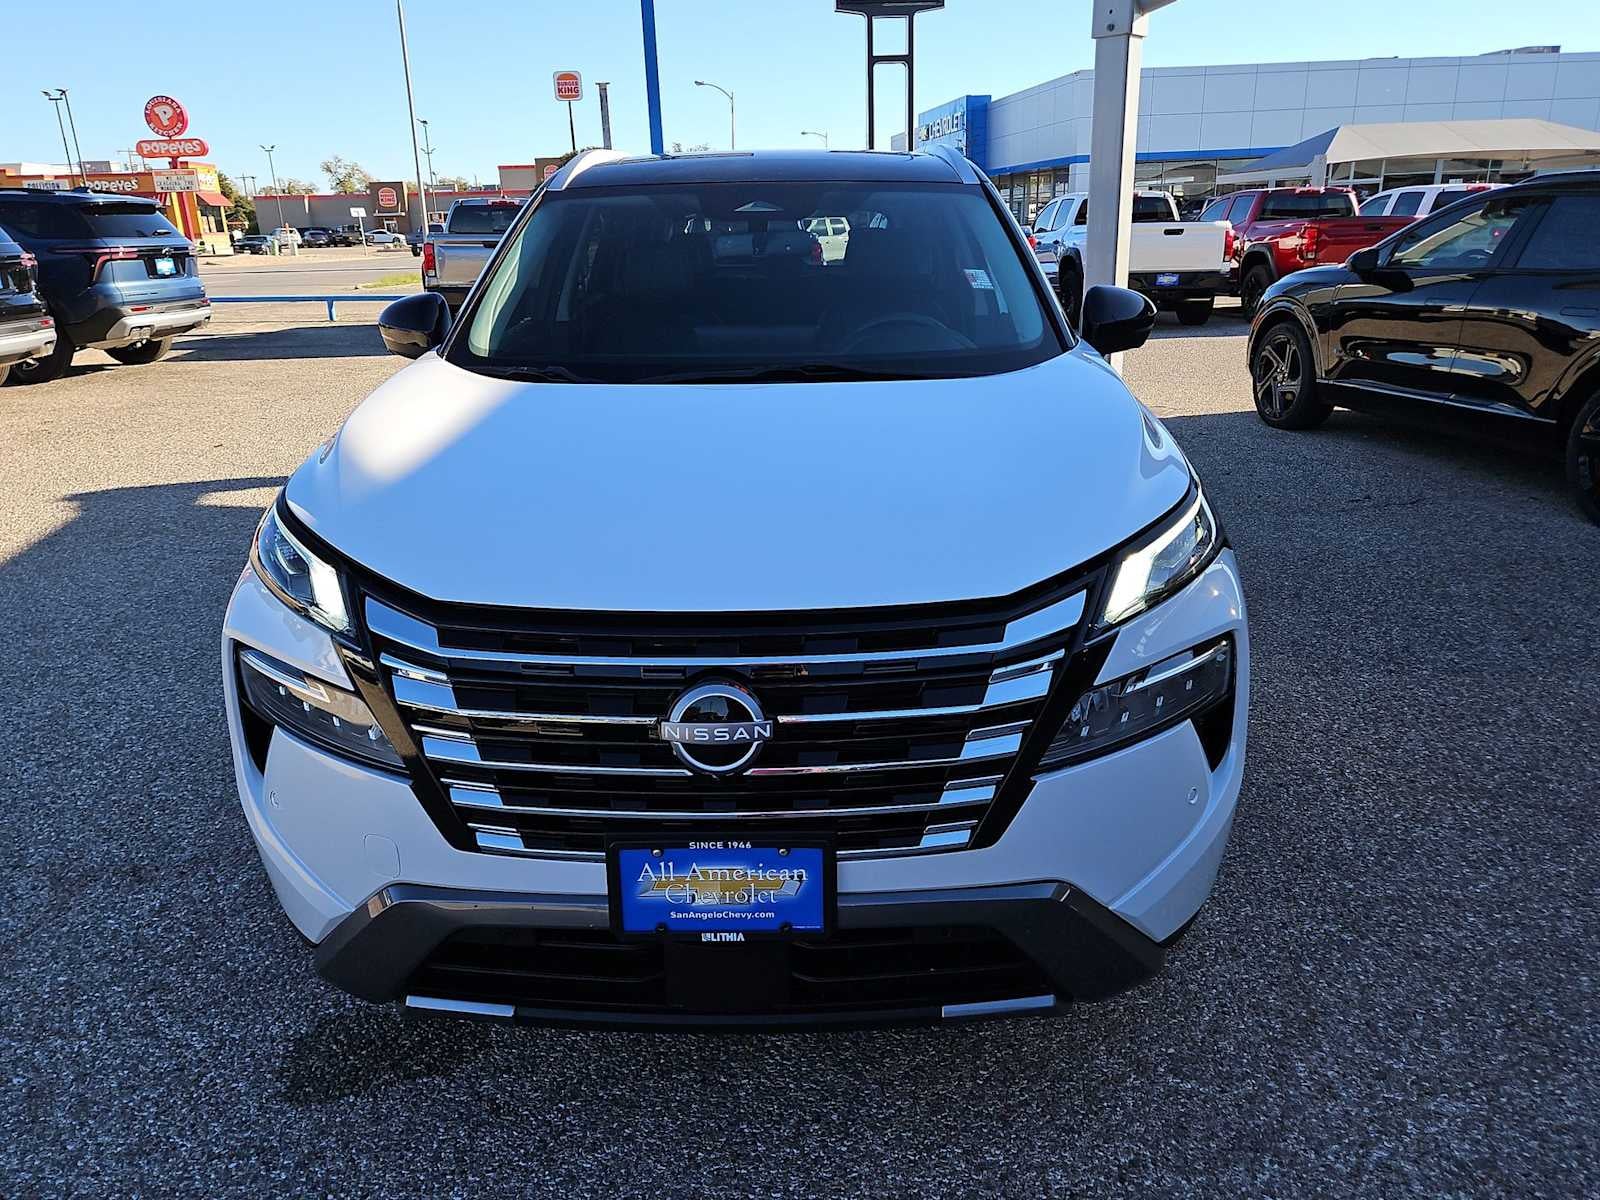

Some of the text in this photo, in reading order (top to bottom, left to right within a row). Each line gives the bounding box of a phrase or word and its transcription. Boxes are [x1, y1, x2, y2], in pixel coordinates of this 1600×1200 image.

[145, 97, 181, 114] LOUISIANA
[153, 104, 174, 127] P
[149, 121, 183, 136] KITCHEN
[929, 111, 964, 138] CHEVROLET
[664, 724, 771, 741] NISSAN
[637, 861, 809, 882] All American
[665, 883, 777, 904] Chevrolet
[670, 911, 775, 920] SanAngeloChevy.com
[711, 932, 745, 942] LITHIA
